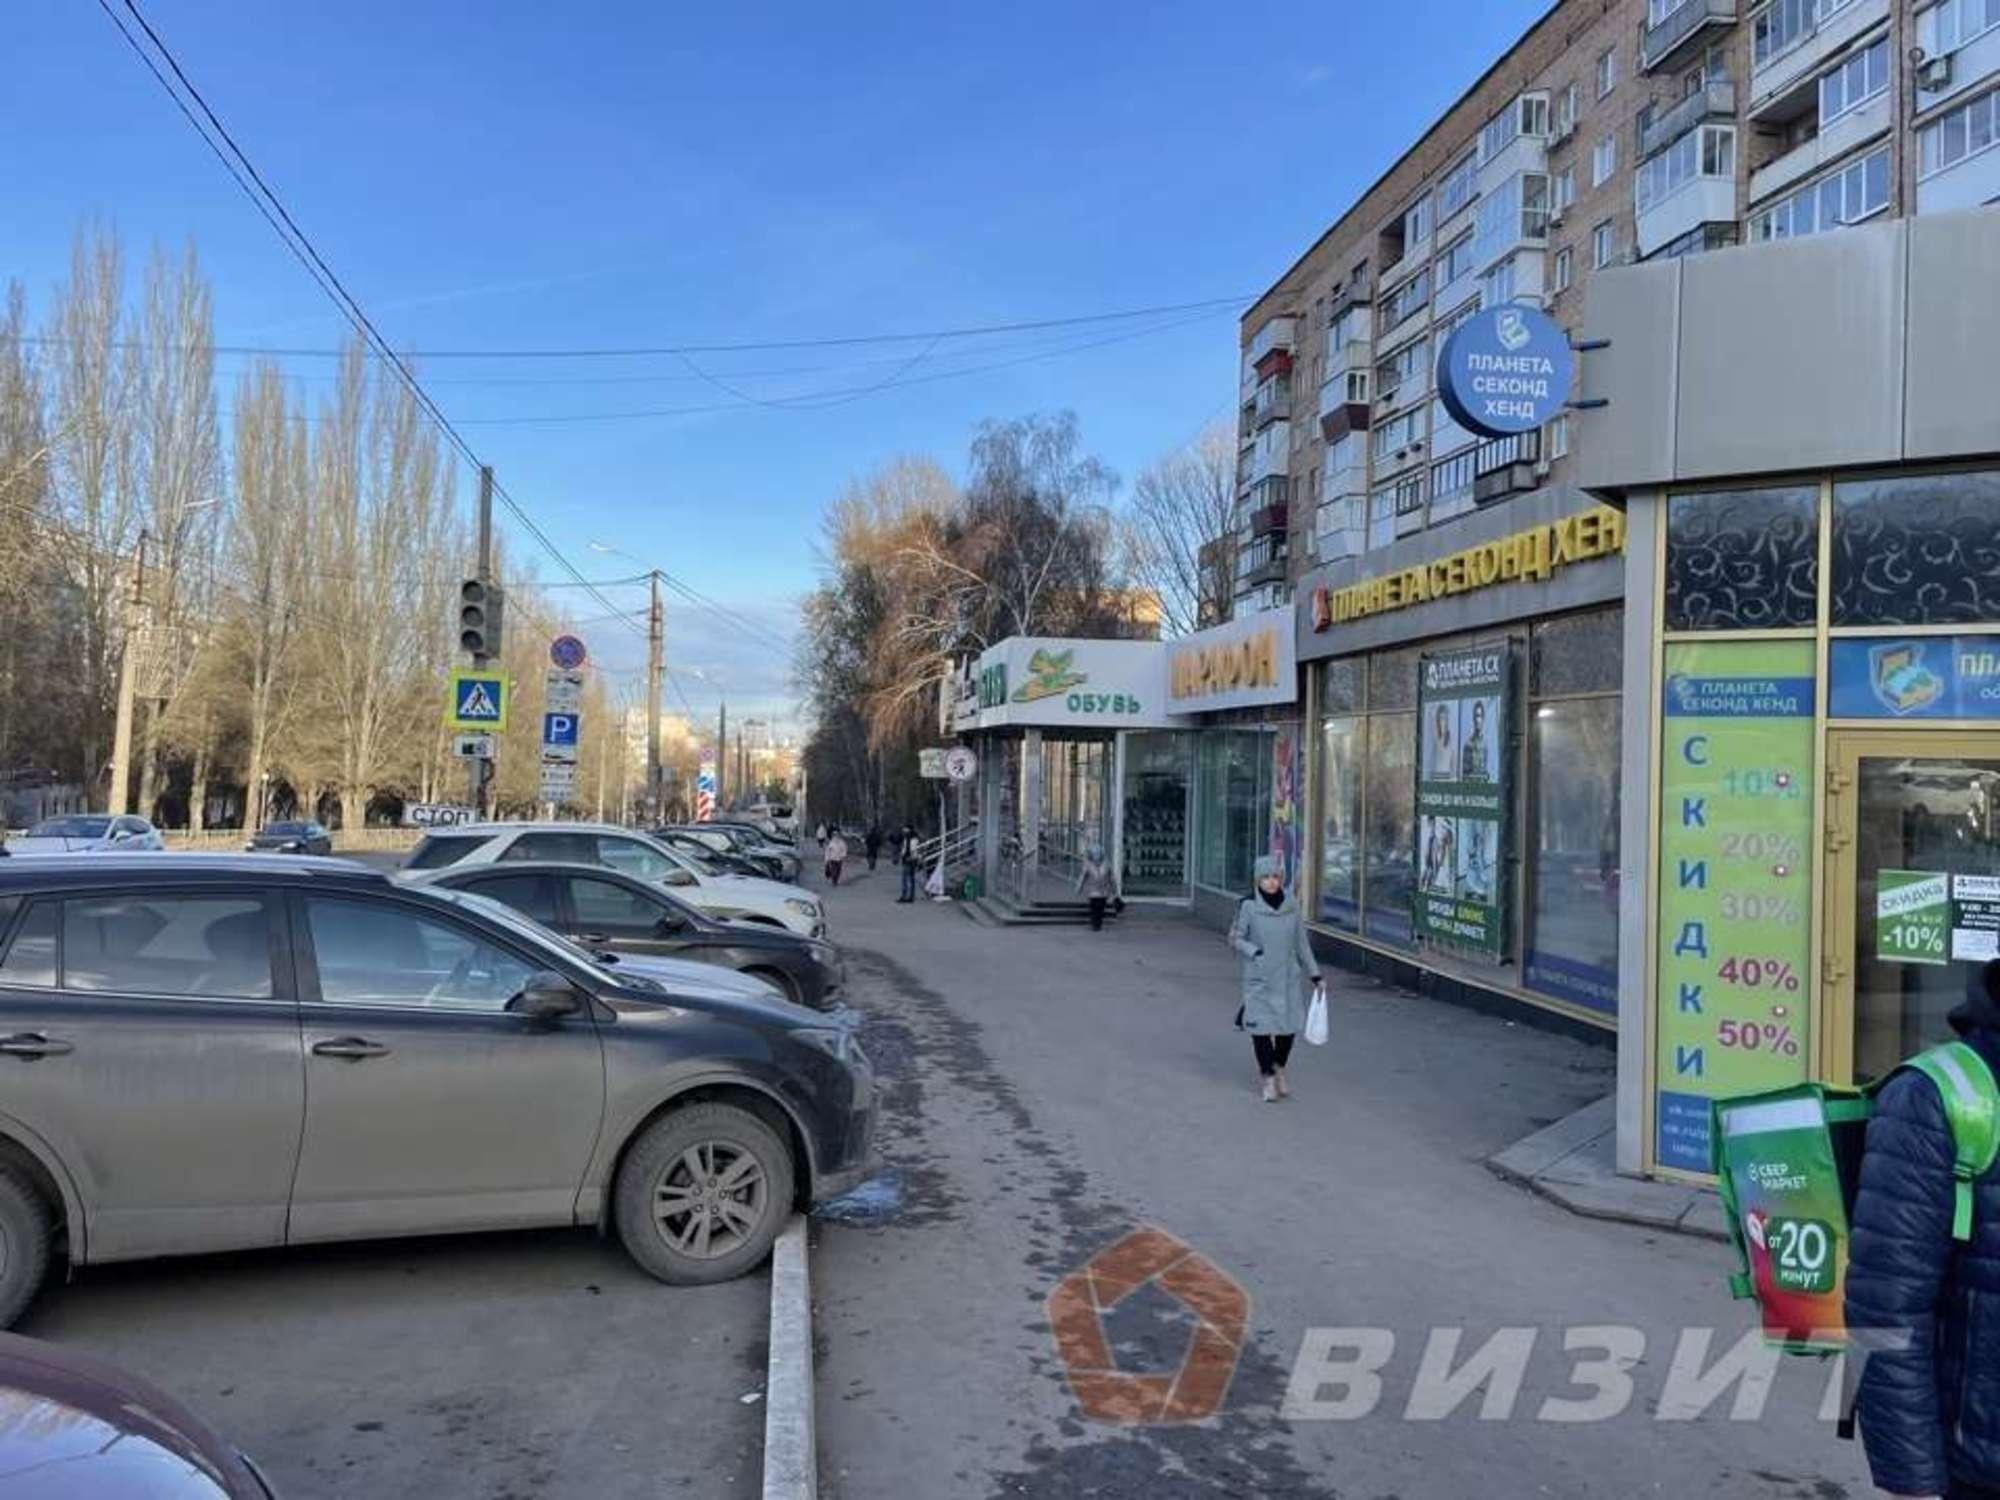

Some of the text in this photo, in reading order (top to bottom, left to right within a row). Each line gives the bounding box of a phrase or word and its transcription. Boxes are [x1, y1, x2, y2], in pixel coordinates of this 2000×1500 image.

[1467, 353, 1554, 374] ПЛАНЕТА
[1472, 376, 1548, 398] СЕКОНД
[1485, 400, 1535, 420] ХЕНД
[1426, 525, 1551, 598] СЕКОНД
[1551, 503, 1627, 566] ХЕН
[1961, 654, 2000, 675] ПЛ
[1702, 682, 1778, 695] ПЛАНЕТА
[1066, 693, 1142, 714] ОБУВЬ
[1683, 697, 1798, 713] СЕКОНД ХЕНД
[1722, 768, 1800, 799] 10%
[412, 807, 470, 827] СТОП
[1721, 832, 1800, 863] 20%
[1675, 736, 1709, 1077] СКИДКИ
[1720, 893, 1800, 925] 30%
[1883, 926, 1944, 952] -10%
[1718, 957, 1798, 991] 40%
[1718, 1019, 1798, 1055] 50%
[1759, 1163, 1788, 1177] СБЕР
[1761, 1175, 1807, 1190] МАРКЕТ
[1781, 1220, 1827, 1269] 20
